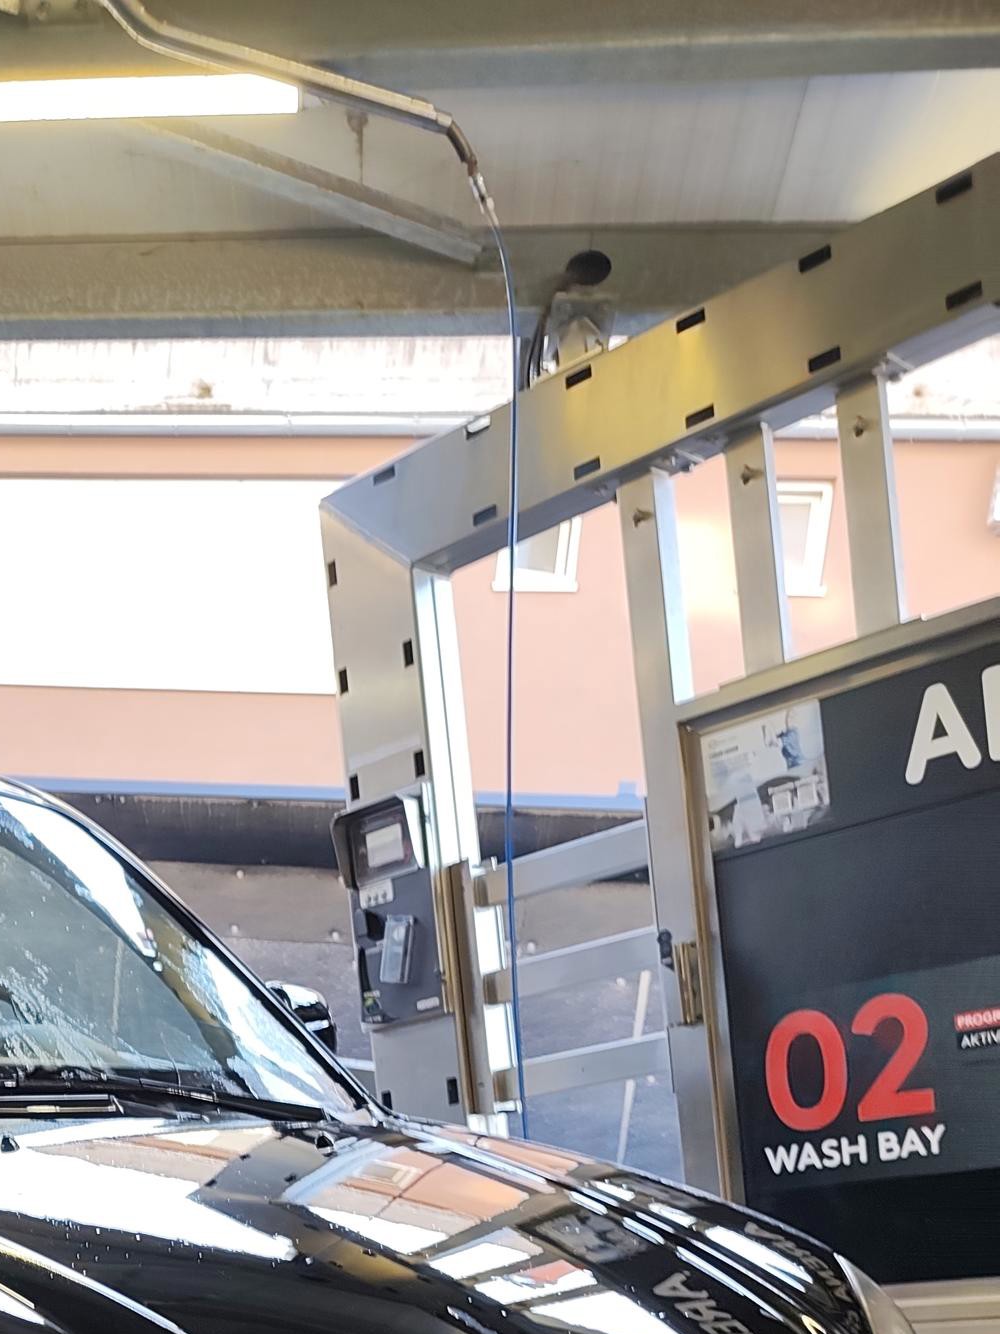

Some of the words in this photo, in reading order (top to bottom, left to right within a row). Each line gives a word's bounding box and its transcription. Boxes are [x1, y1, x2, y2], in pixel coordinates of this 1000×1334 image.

[765, 992, 936, 1132] 02
[764, 1134, 868, 1175] WASH
[877, 1124, 946, 1162] BAY
